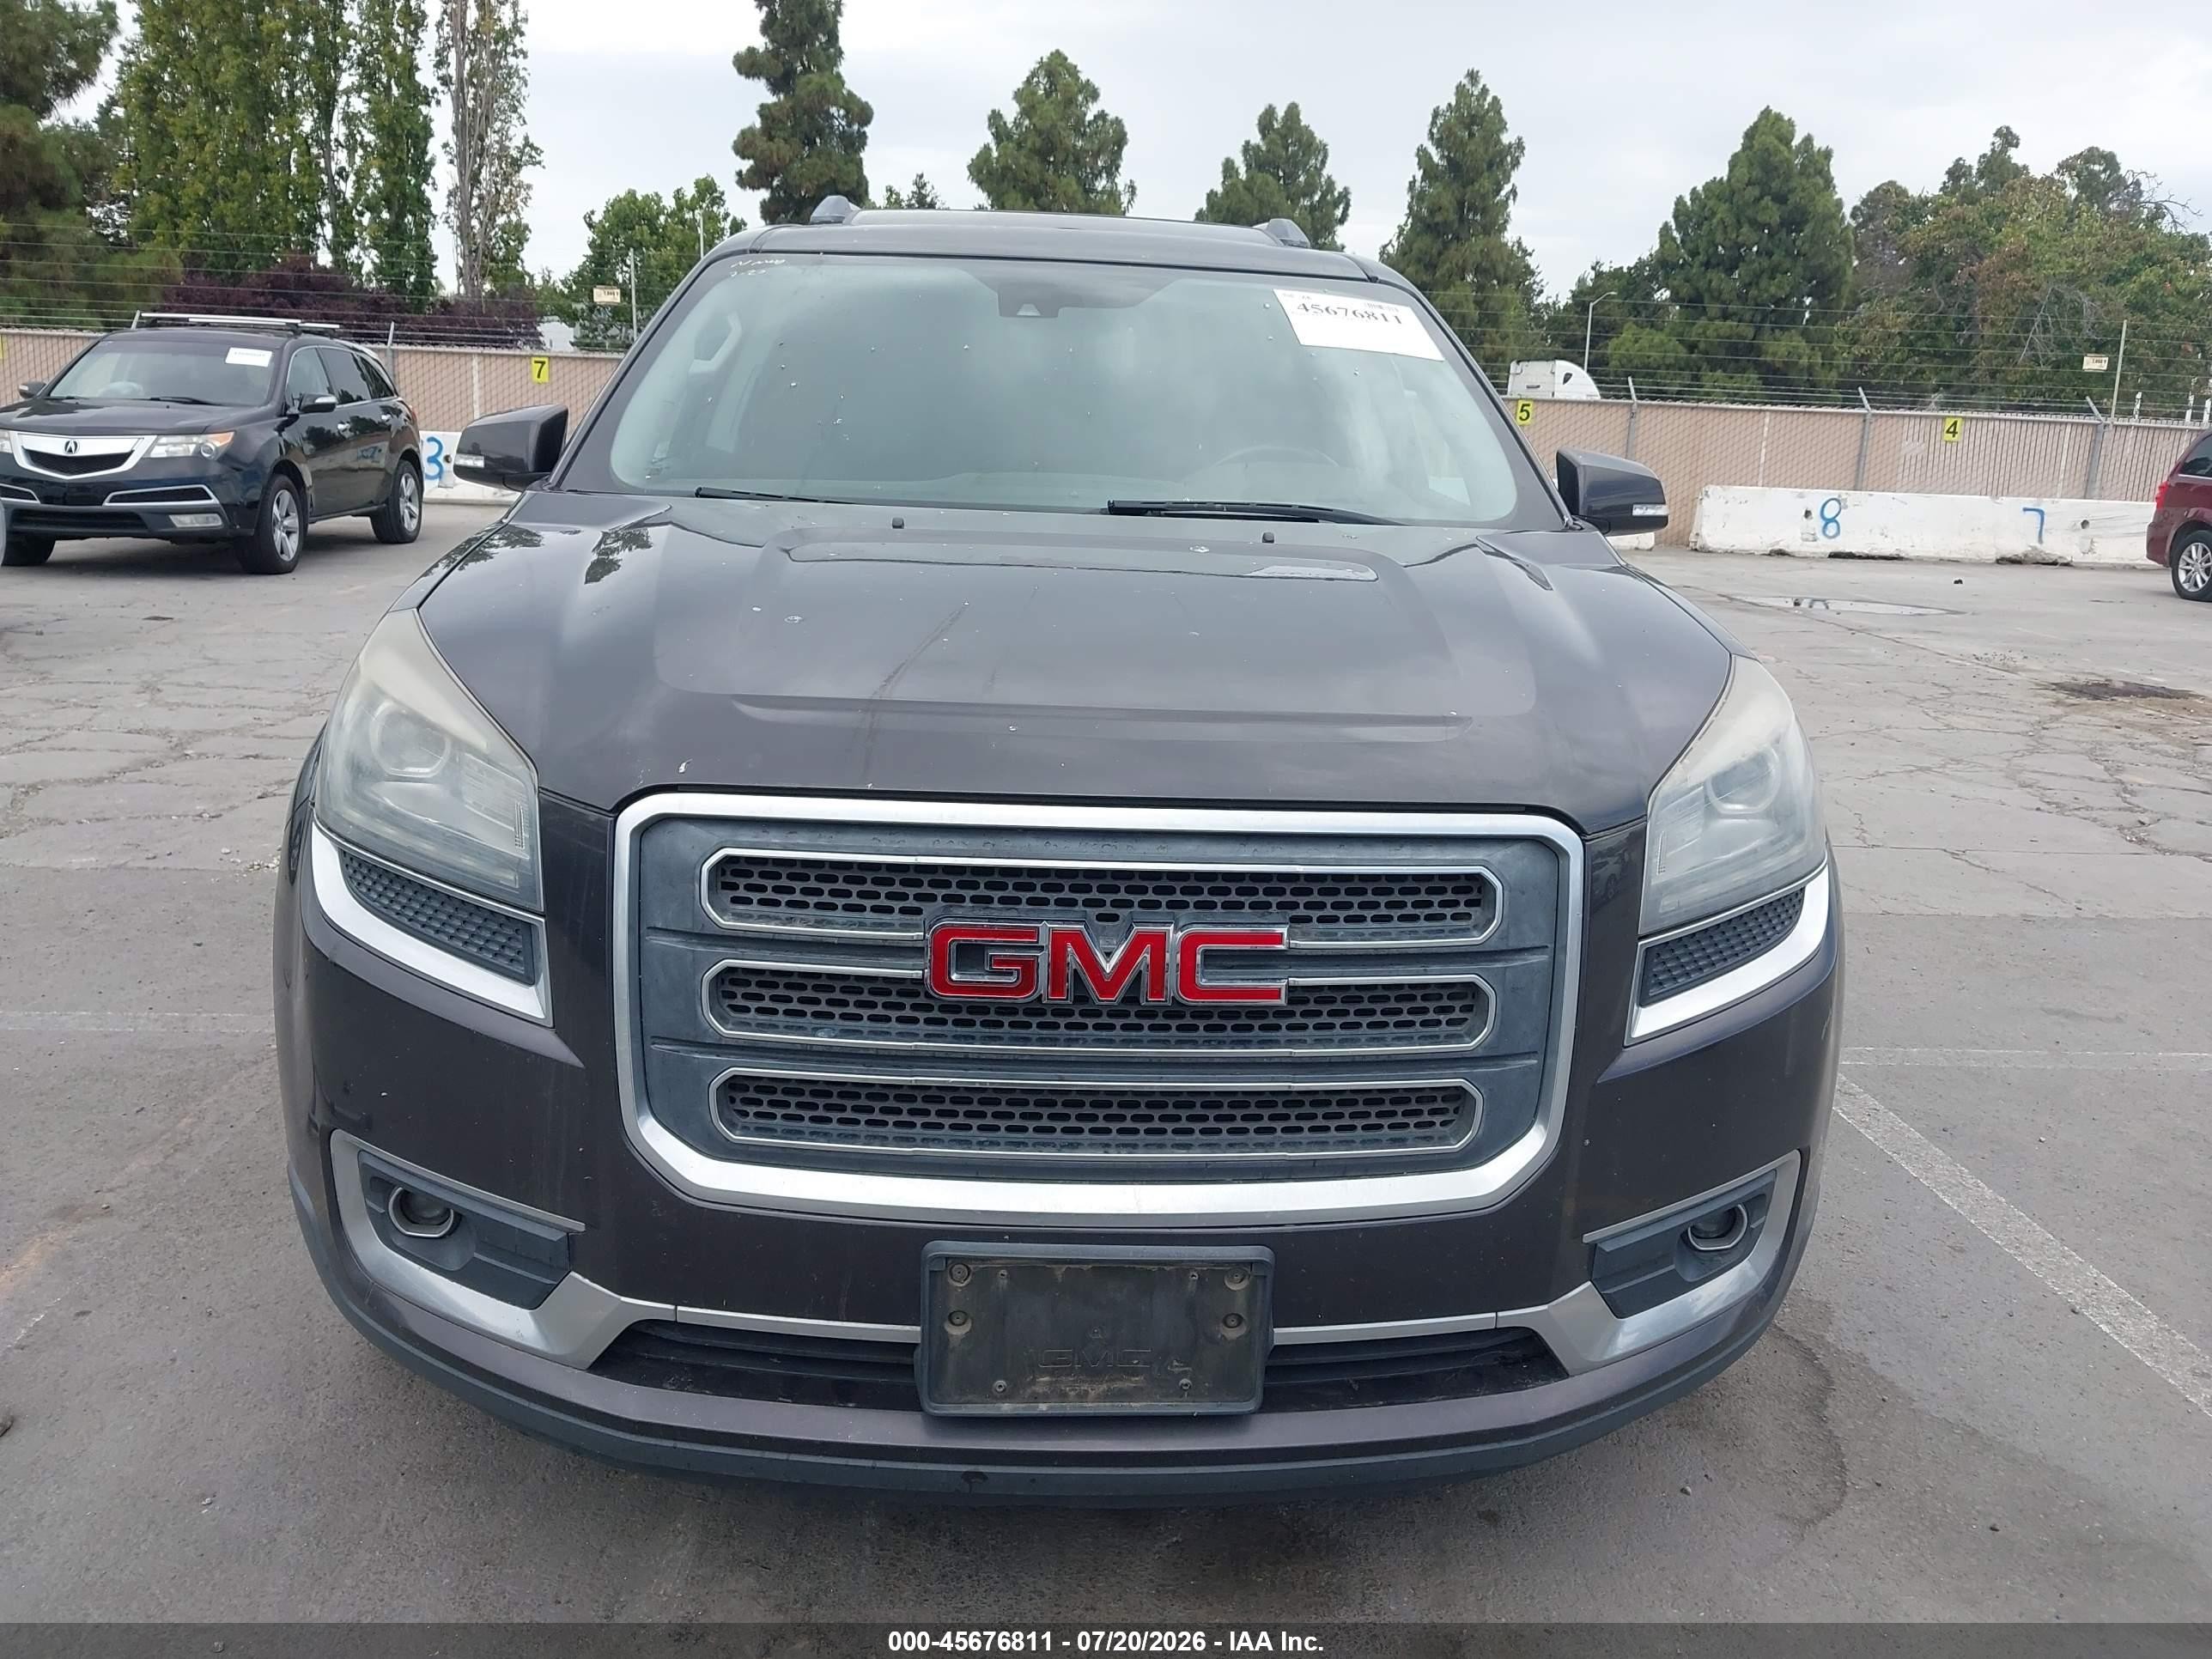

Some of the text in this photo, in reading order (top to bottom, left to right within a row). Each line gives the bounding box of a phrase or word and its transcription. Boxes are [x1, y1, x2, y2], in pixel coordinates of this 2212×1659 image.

[1297, 303, 1401, 324] 45676811
[533, 361, 548, 379] 7
[1518, 403, 1531, 422] 5
[1945, 419, 1959, 438] 4
[424, 435, 445, 481] 3
[1820, 497, 1842, 539] 8
[2022, 506, 2045, 544] 7
[925, 920, 1290, 1006] GMC
[1038, 1348, 1152, 1368] GMC
